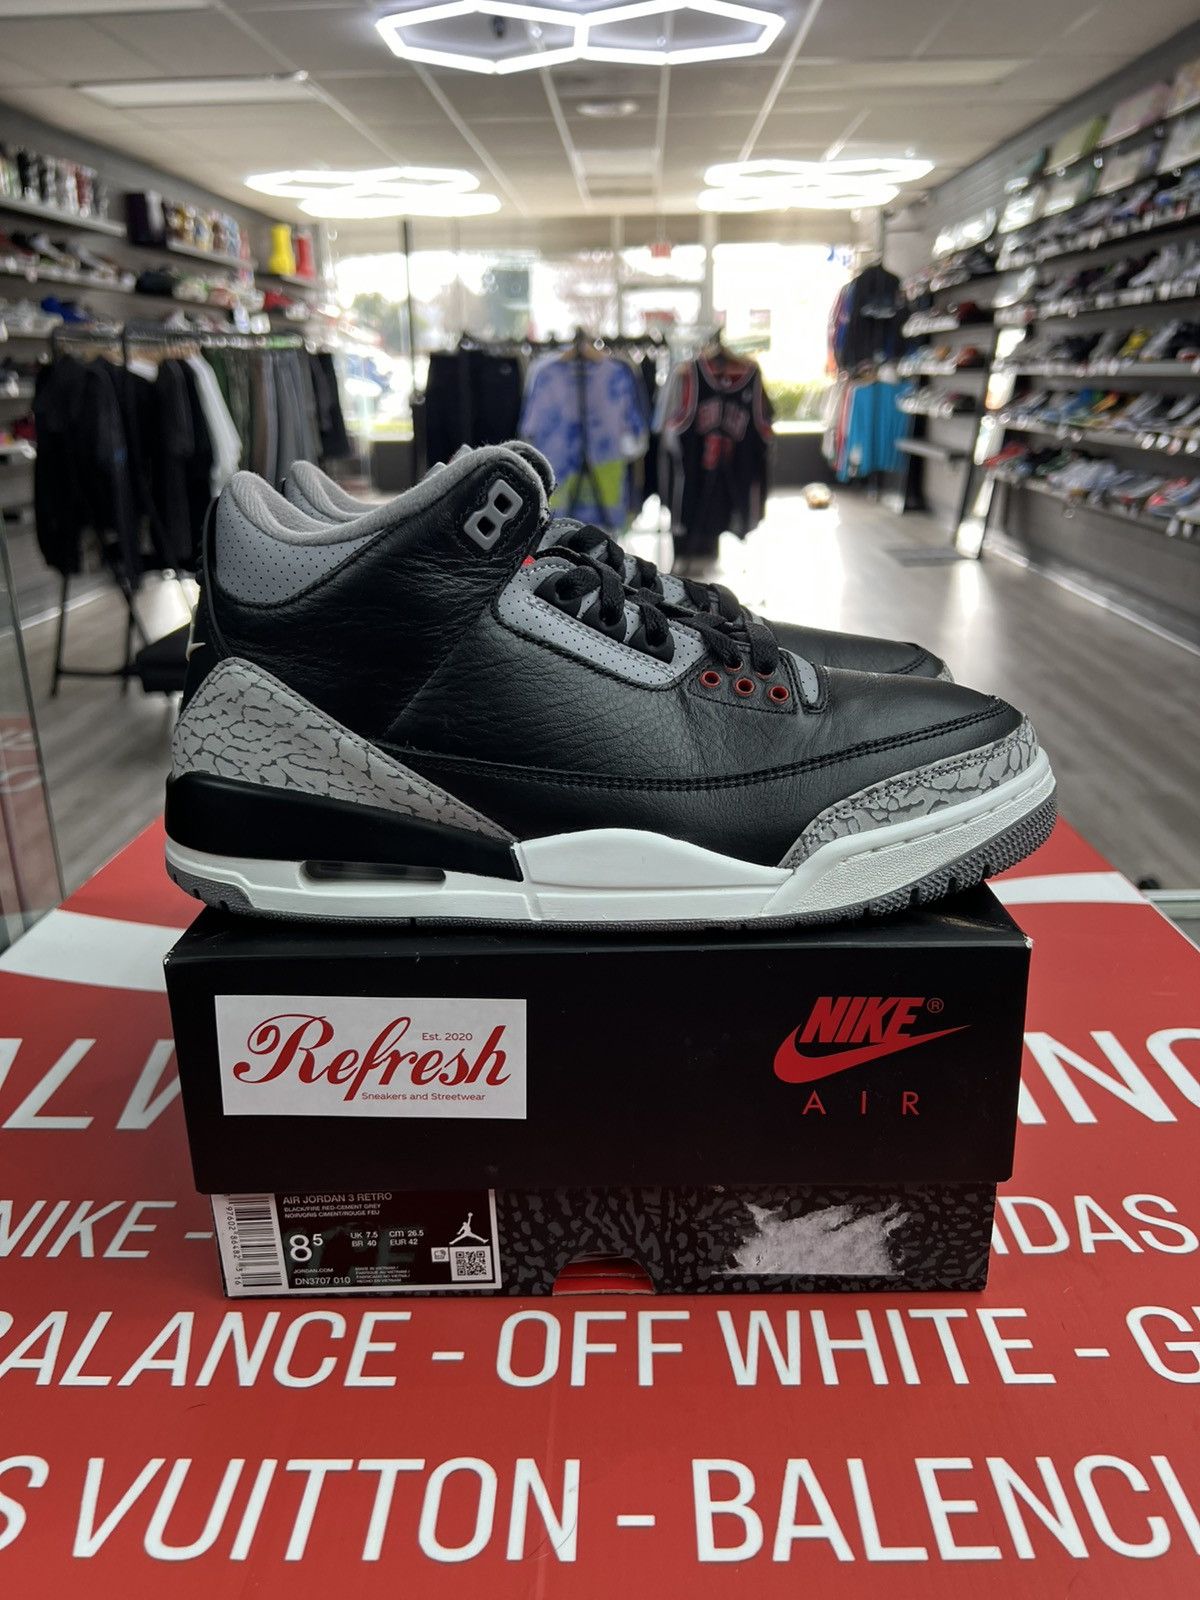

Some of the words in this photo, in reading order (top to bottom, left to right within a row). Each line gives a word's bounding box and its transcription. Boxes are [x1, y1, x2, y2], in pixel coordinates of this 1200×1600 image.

[800, 997, 925, 1043] NIKE
[422, 1032, 442, 1041] Est.
[445, 1032, 473, 1041] 2020
[233, 1013, 511, 1102] Refresh
[361, 1092, 406, 1101] Sneakers
[411, 1092, 427, 1101] and
[431, 1092, 486, 1101] Streetwear
[802, 1089, 920, 1116] AIR
[283, 1197, 301, 1205] AIR
[303, 1194, 346, 1204] JORDAN
[348, 1193, 355, 1202] 3
[357, 1192, 393, 1202] RETRO
[350, 1232, 363, 1240] UK
[366, 1231, 379, 1239] 7.5
[408, 1230, 424, 1238] 26.5
[352, 1239, 364, 1247] BR
[367, 1239, 377, 1247] 40
[408, 1238, 419, 1246] 42
[295, 1277, 331, 1286] DN3707
[334, 1276, 350, 1285] 010
[0, 1310, 411, 1388] ALANCE
[496, 1310, 690, 1388] OFF
[717, 1308, 1057, 1386] WHITE
[1125, 1306, 1200, 1384] G
[72, 1457, 580, 1563] VUITTON
